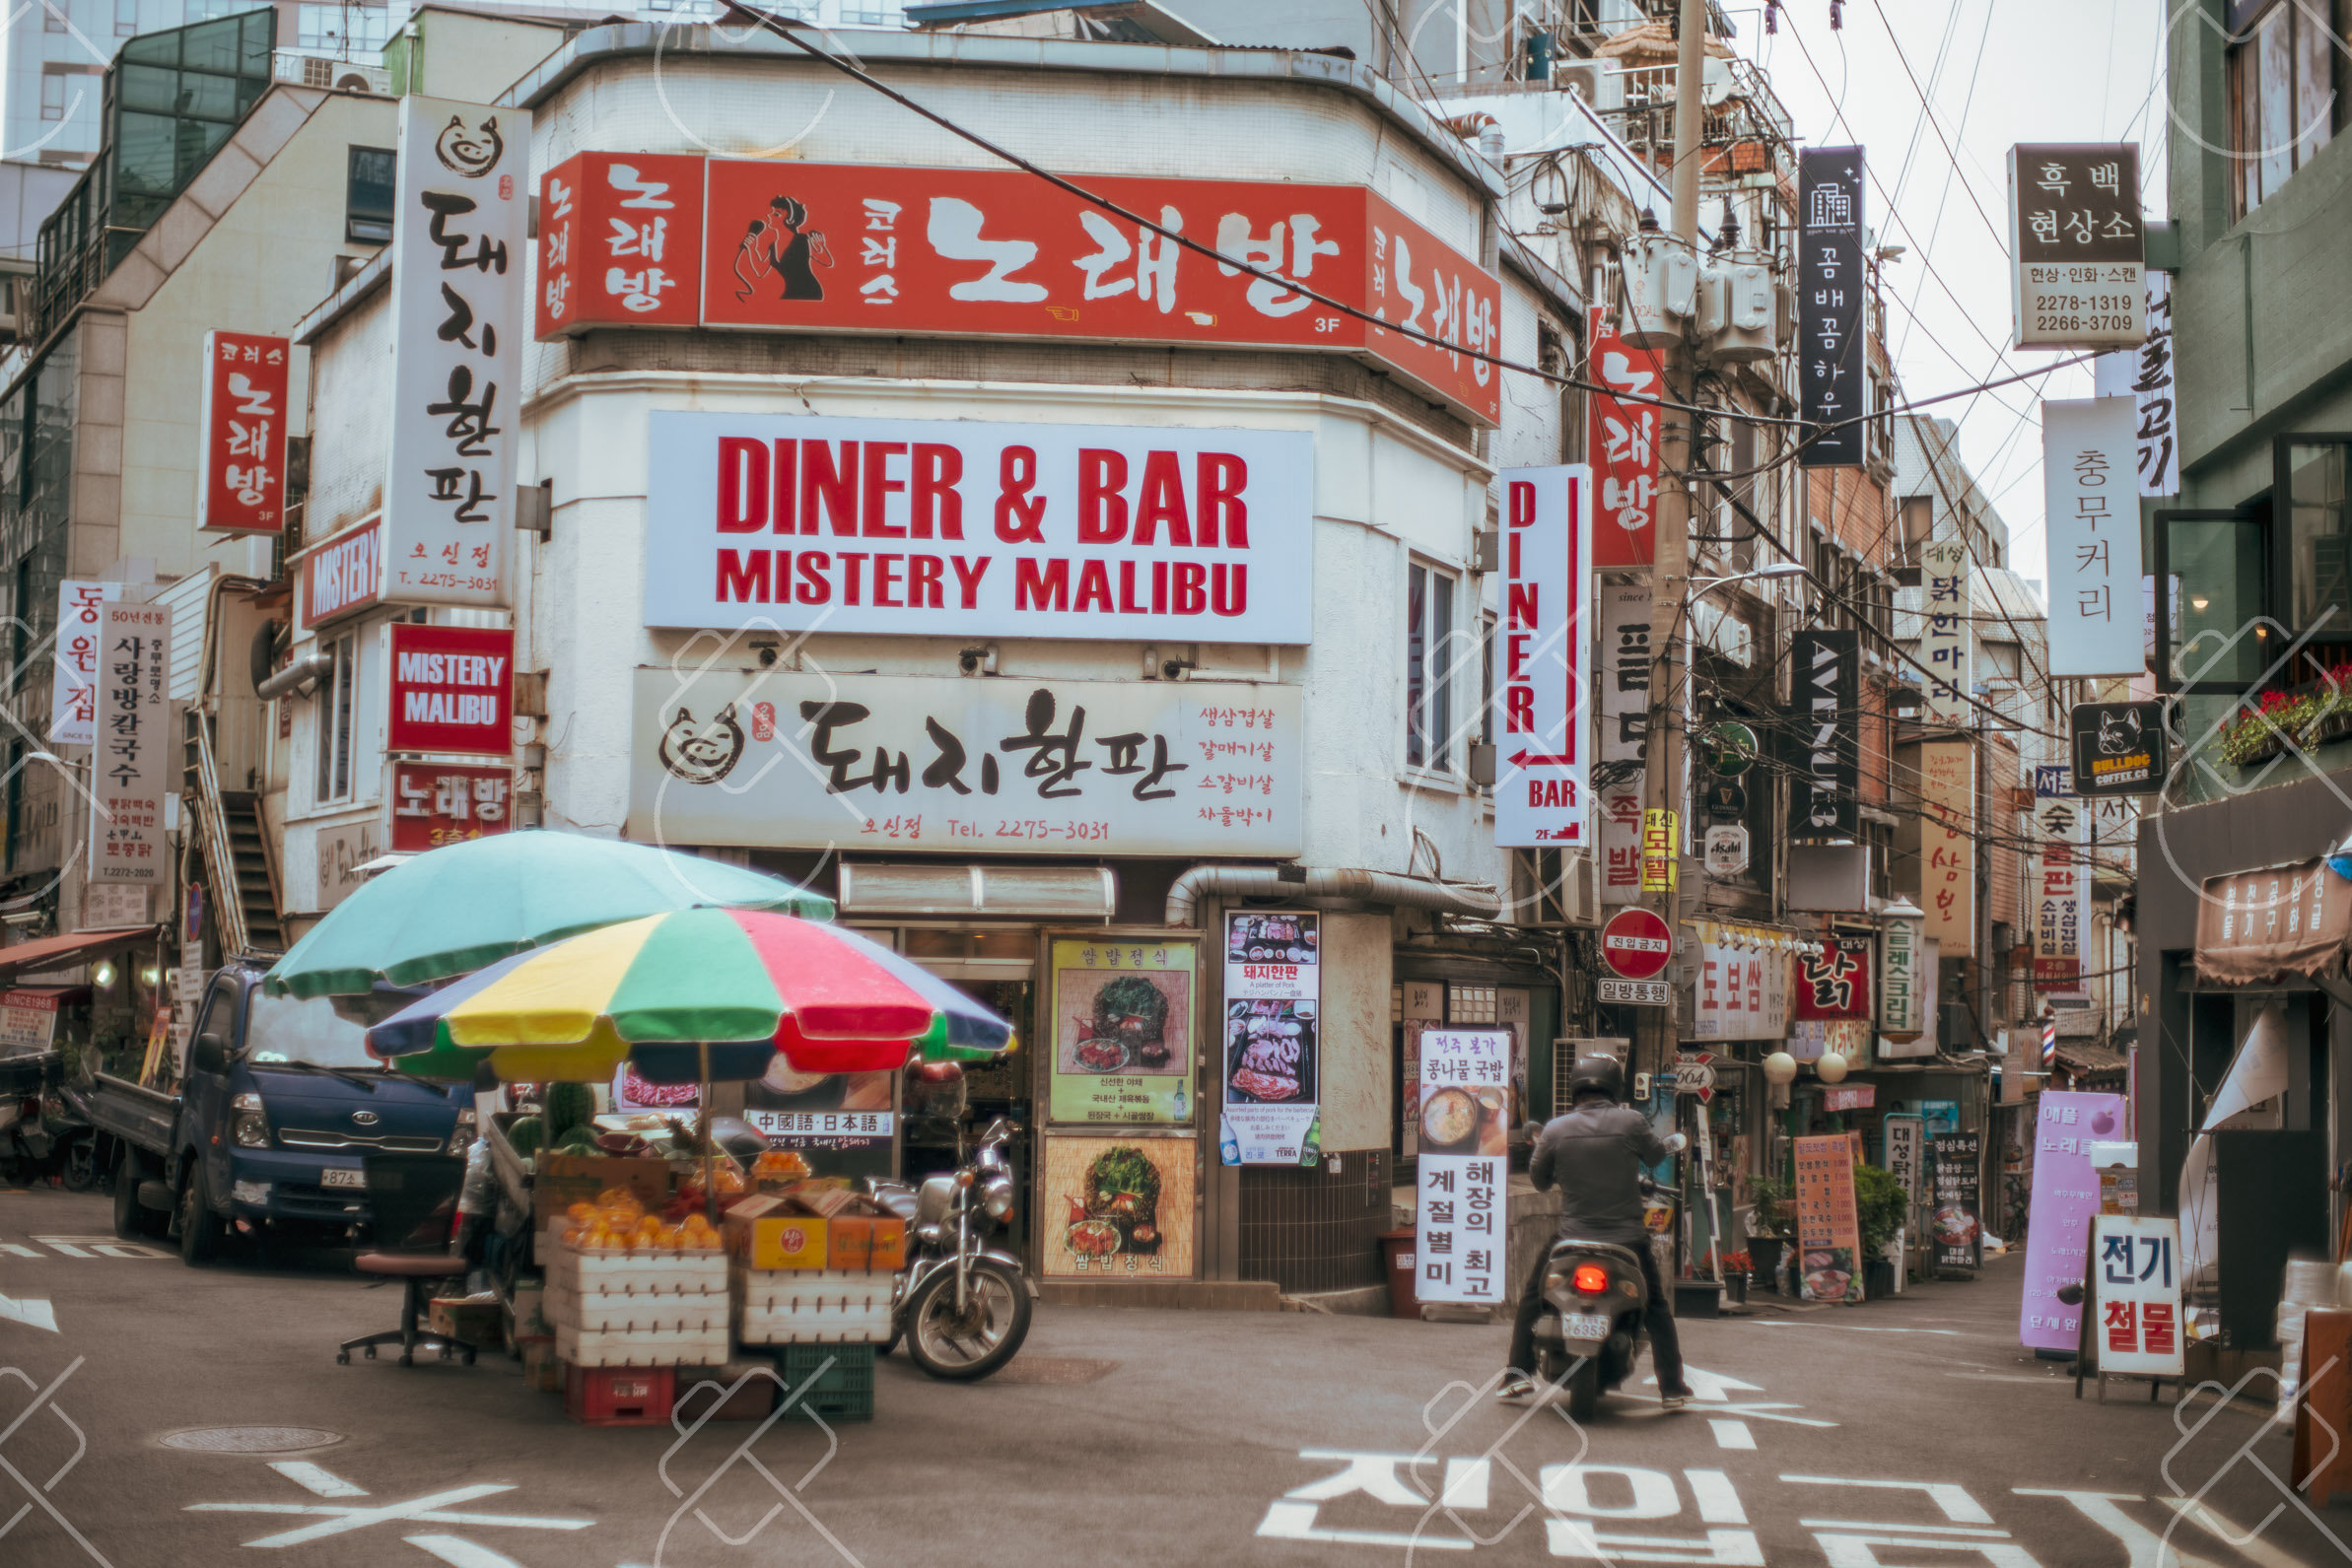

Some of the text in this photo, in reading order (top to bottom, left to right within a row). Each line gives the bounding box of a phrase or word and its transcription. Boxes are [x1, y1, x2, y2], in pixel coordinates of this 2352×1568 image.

[2037, 163, 2120, 197] 흑백
[606, 164, 675, 312] 노래방
[2028, 209, 2136, 243] 현상소
[546, 178, 572, 319] 노래방
[860, 199, 903, 304] 코러스
[928, 196, 1340, 317] 노래방
[1395, 236, 1495, 386] 노래방
[2037, 296, 2132, 310] 2278-1319
[1315, 317, 1340, 333] 3F
[2038, 315, 2132, 331] 2266-3709
[221, 343, 283, 366] 코러스
[420, 191, 507, 523] 돼지한판
[226, 372, 275, 506] 노래방
[1602, 352, 1660, 530] 노래방
[716, 437, 1250, 549] DINER & BAR
[258, 511, 274, 521] 3F
[2074, 449, 2111, 623] 충무커리
[312, 525, 380, 618] MISTERY
[419, 574, 498, 590] 2275-3031
[716, 549, 1247, 616] MISTERY MALIBU
[1506, 481, 1538, 733] DINER
[1619, 592, 1644, 602] since
[111, 611, 165, 625] 50년전통
[398, 652, 503, 687] MISTERY
[109, 637, 144, 787] 사랑방칼국수
[405, 692, 496, 724] MALIBU
[1199, 707, 1276, 729] 생삼겹살
[799, 688, 1188, 800] 돼지한판
[1199, 739, 1275, 763] 갈매기살
[2093, 754, 2151, 774] BULLDOG
[396, 775, 510, 820] 노래방
[1198, 773, 1275, 794] 소갈비살
[1528, 780, 1576, 808] BAR
[861, 814, 1109, 840] 오신정 Tel. 2275-3031
[1198, 806, 1273, 828] 차돌박이
[1536, 829, 1551, 840] 2F
[1608, 795, 1641, 886] 족발
[1711, 842, 1741, 853] Asahi
[1644, 830, 1672, 879] 모텔
[1613, 937, 1663, 951] 진입금지
[1244, 966, 1298, 980] 돼지한판
[1802, 951, 1856, 1008] 닭
[1603, 983, 1666, 1001] 일방통행
[1435, 1036, 1461, 1054] 전주
[1427, 1059, 1470, 1080] 콩나물
[1475, 1060, 1503, 1082] 국밥
[356, 1114, 375, 1123] KIA
[1276, 1149, 1296, 1158] TERRA
[1426, 1170, 1455, 1286] 계절별미
[1463, 1162, 1493, 1297] 해장의 최고
[2102, 1235, 2171, 1288] 전기
[2105, 1301, 2175, 1354] 철물
